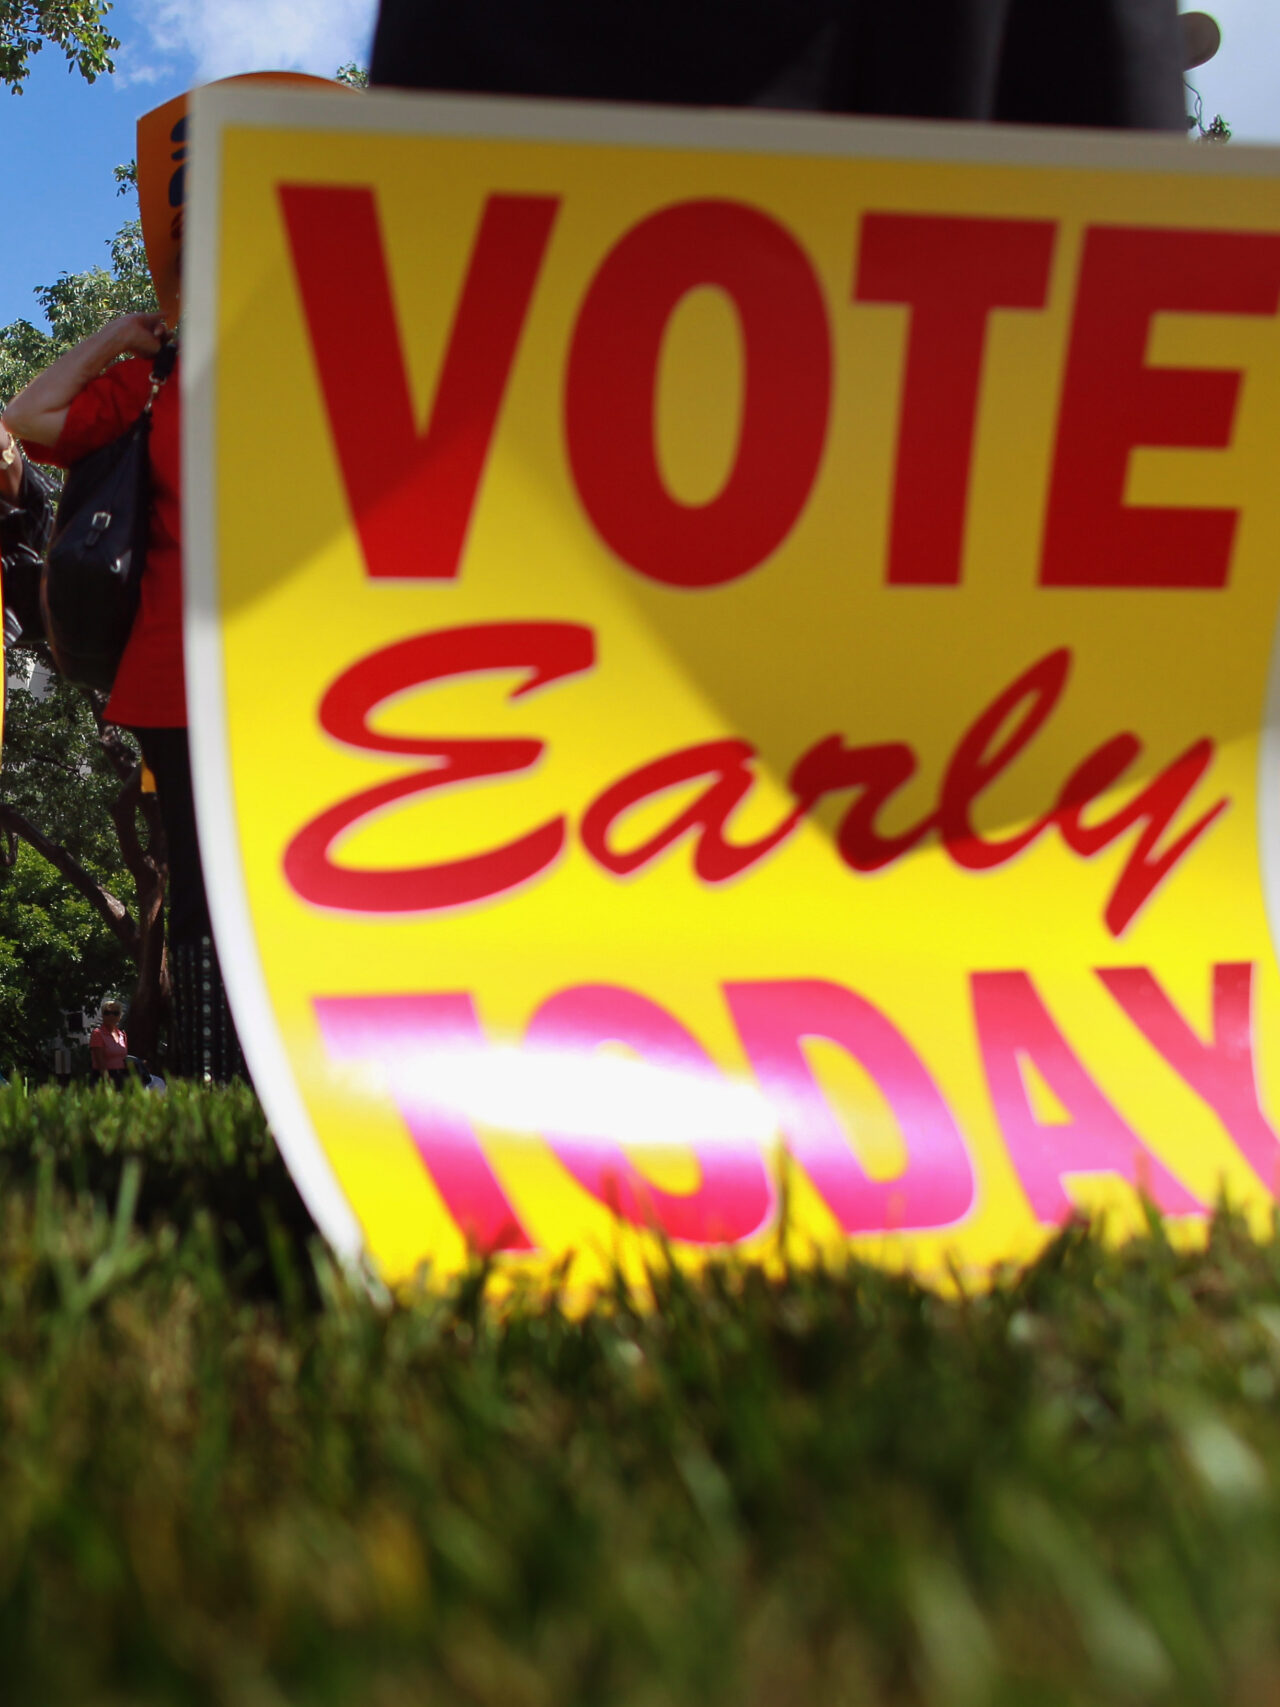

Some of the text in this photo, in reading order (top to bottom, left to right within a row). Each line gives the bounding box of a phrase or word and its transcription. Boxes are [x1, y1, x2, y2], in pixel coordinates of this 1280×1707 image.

[274, 180, 1280, 592] VOTE
[280, 619, 1233, 940] Early
[310, 960, 1280, 1254] TODAY
